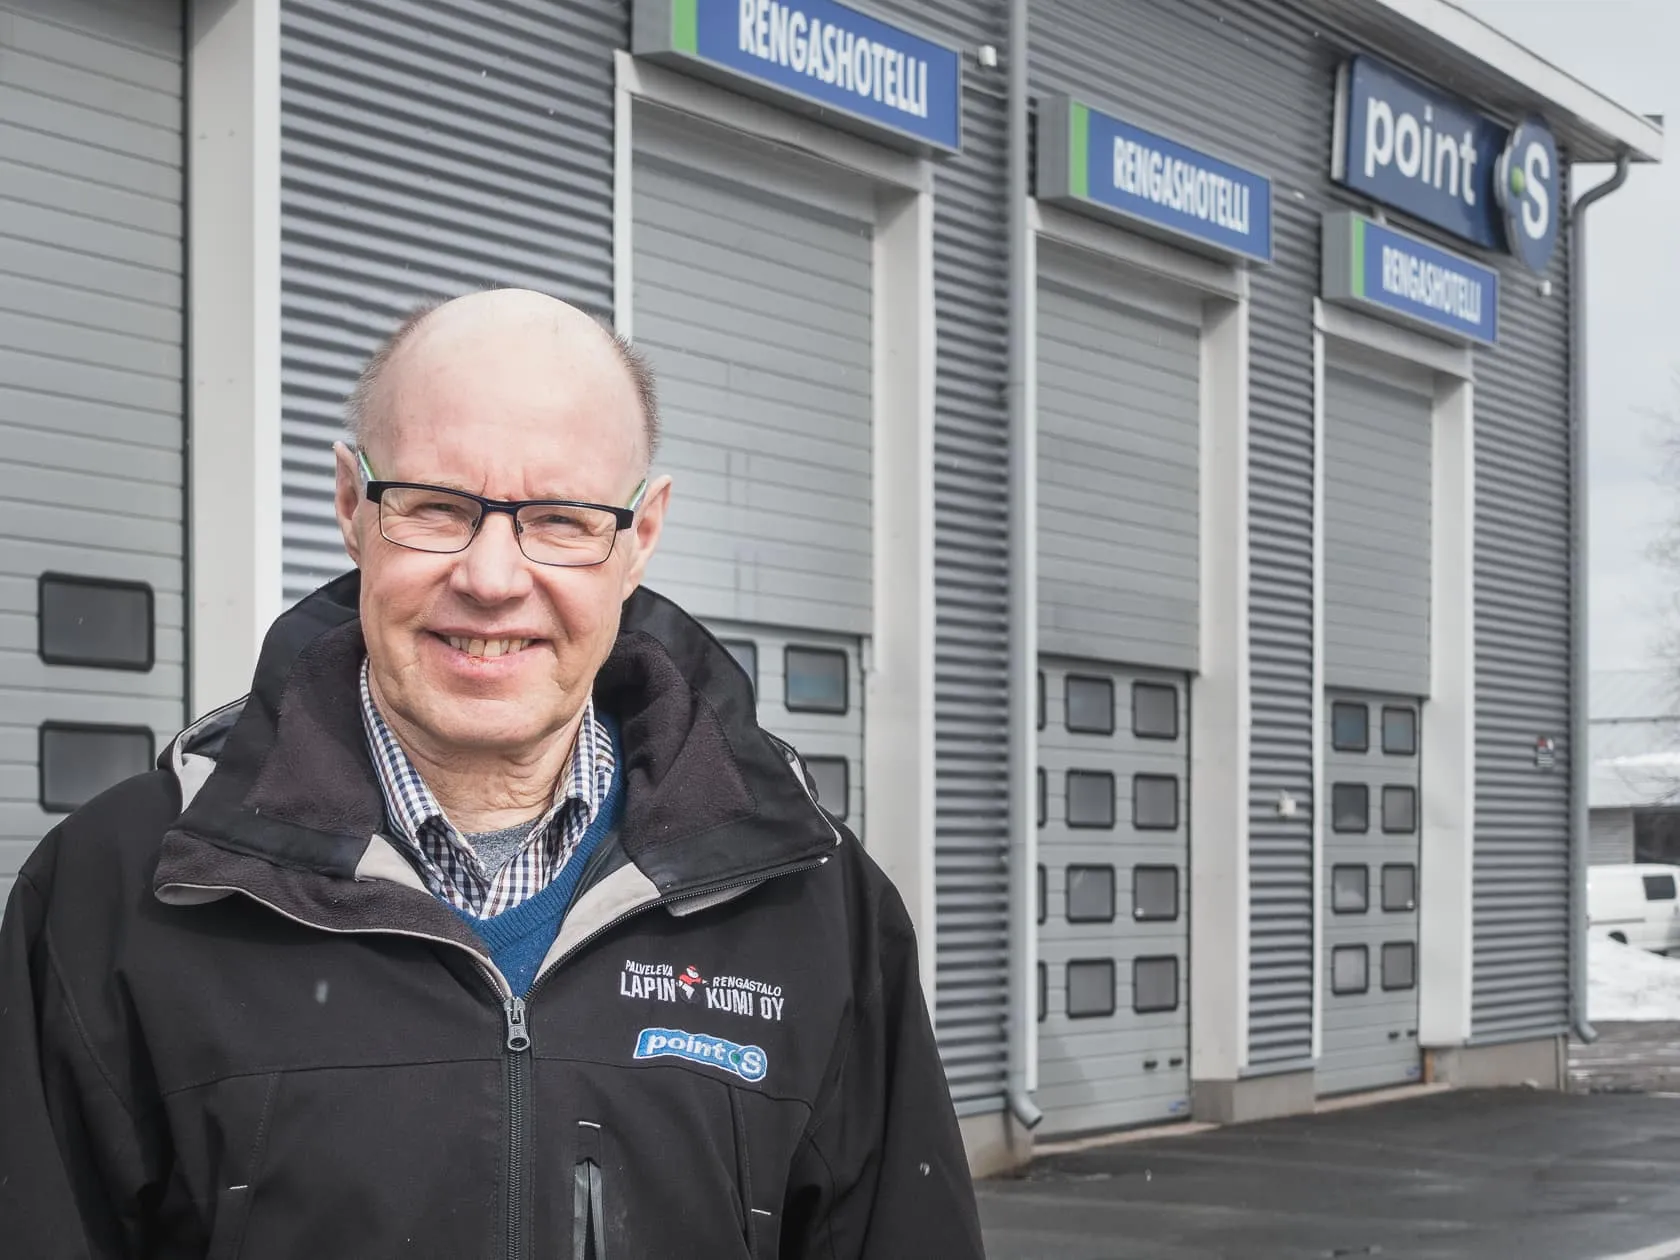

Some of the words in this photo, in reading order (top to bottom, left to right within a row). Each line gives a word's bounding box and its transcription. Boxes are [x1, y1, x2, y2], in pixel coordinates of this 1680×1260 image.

[738, 0, 928, 119] RENGASHOTELLI
[1113, 136, 1249, 234] RENGASHOTELLI
[1364, 97, 1477, 206] point
[1522, 142, 1550, 240] S
[1382, 246, 1482, 325] RENGASHOTELLI
[620, 971, 676, 1002] LAPIN
[705, 988, 753, 1016] KUMI
[760, 997, 784, 1020] OY
[625, 960, 673, 976] PALVELEVA
[713, 976, 781, 997] RENGASTALO
[647, 1034, 726, 1060] point
[742, 1051, 762, 1074] S
